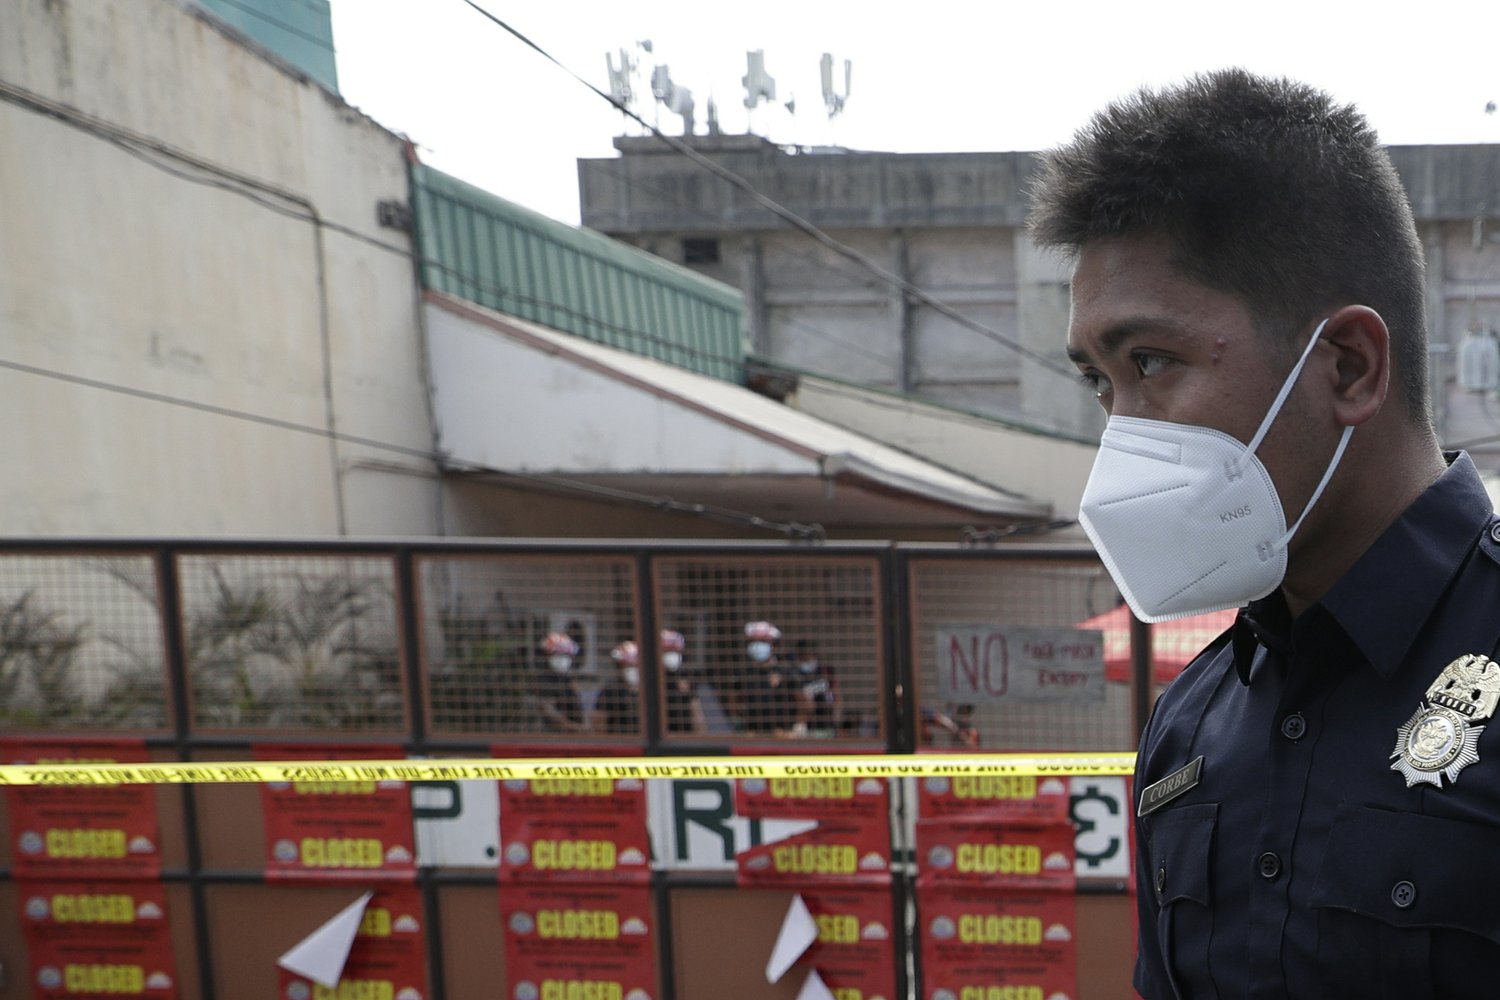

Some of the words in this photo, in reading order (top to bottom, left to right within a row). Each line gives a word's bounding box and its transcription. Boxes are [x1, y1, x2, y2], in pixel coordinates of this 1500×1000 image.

[1219, 505, 1253, 524] KN95
[949, 632, 1009, 697] NO
[1149, 768, 1190, 803] CORBE
[532, 840, 616, 871] CLOSED
[773, 843, 858, 874] CLOSED
[956, 843, 1041, 875] CLOSED
[536, 909, 619, 940] CLOSED
[817, 914, 860, 944] SED
[958, 914, 1043, 945] CLOSED
